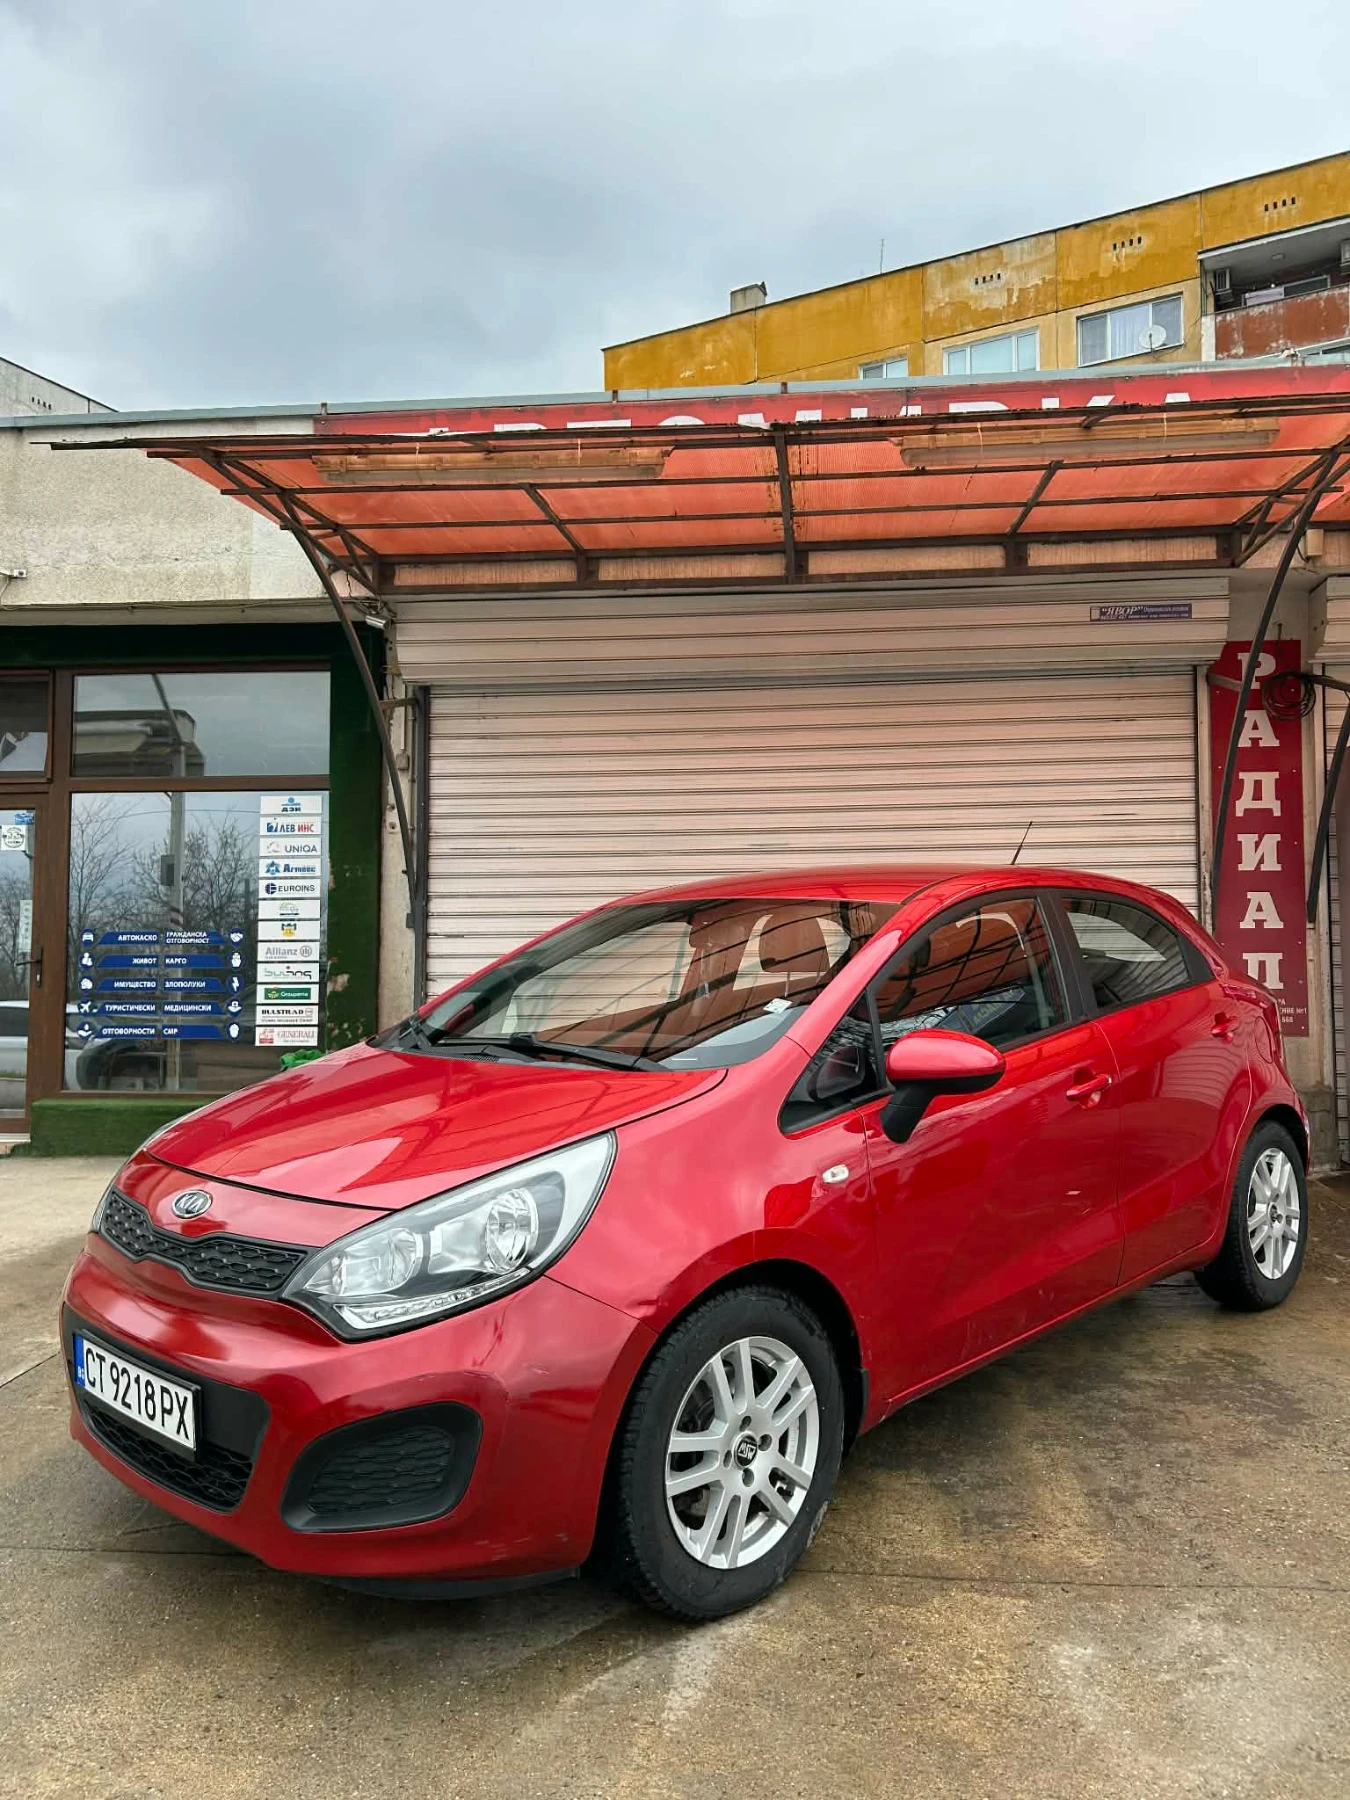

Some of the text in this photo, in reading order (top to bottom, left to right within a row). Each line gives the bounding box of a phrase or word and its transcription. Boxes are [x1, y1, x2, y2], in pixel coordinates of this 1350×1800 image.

[279, 823, 315, 833] ЛЕВ ИНС
[284, 844, 318, 853] UNIQA
[278, 884, 316, 892] EUROINS
[265, 946, 298, 956] Allianz
[132, 957, 157, 965] ЖИВОТ
[165, 957, 187, 965] КАРГО
[105, 1004, 156, 1012] ТУРИСТИЧЕСКИ
[164, 1004, 212, 1012] МЕДИЦИНСКИ
[277, 1030, 315, 1039] GENERALI
